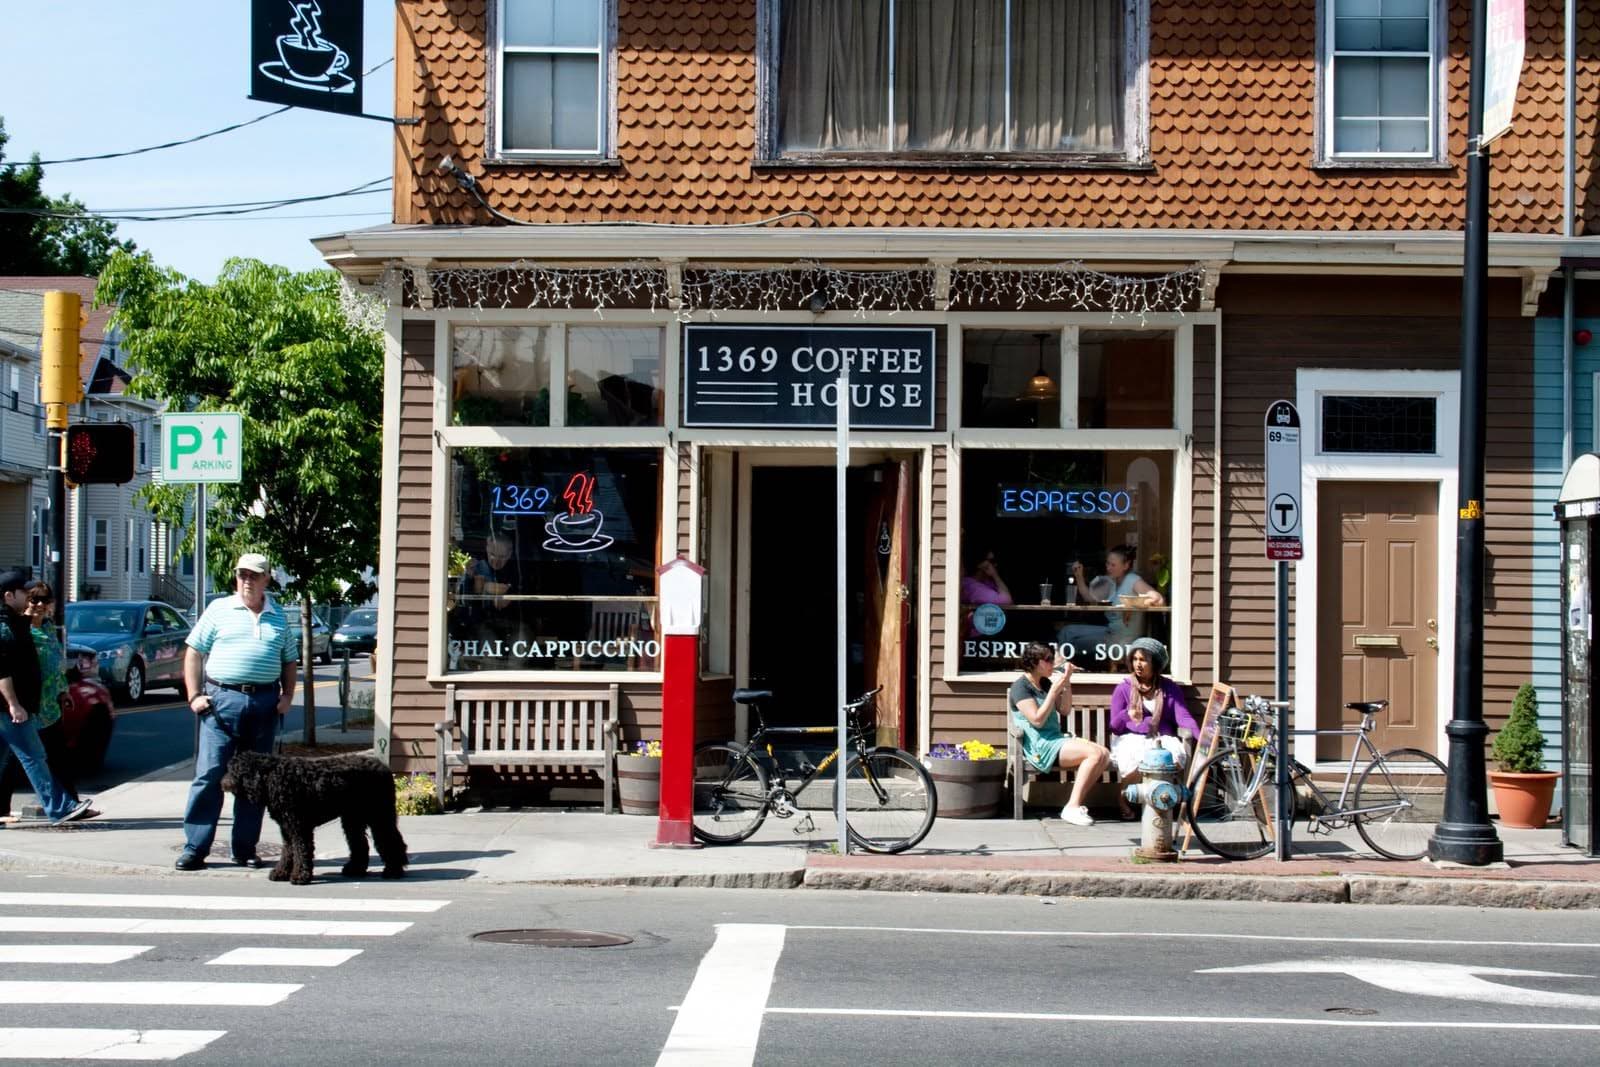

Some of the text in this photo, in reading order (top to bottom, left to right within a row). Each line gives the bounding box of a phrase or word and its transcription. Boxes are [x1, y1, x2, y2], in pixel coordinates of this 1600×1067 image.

[699, 346, 923, 374] 1369 COFFEE
[791, 383, 923, 408] HOUSE
[1269, 431, 1282, 442] 69
[492, 485, 549, 510] 1369
[1003, 490, 1131, 514] ESPRESSO
[1275, 504, 1293, 526] T
[964, 640, 1075, 660] ESPREO
